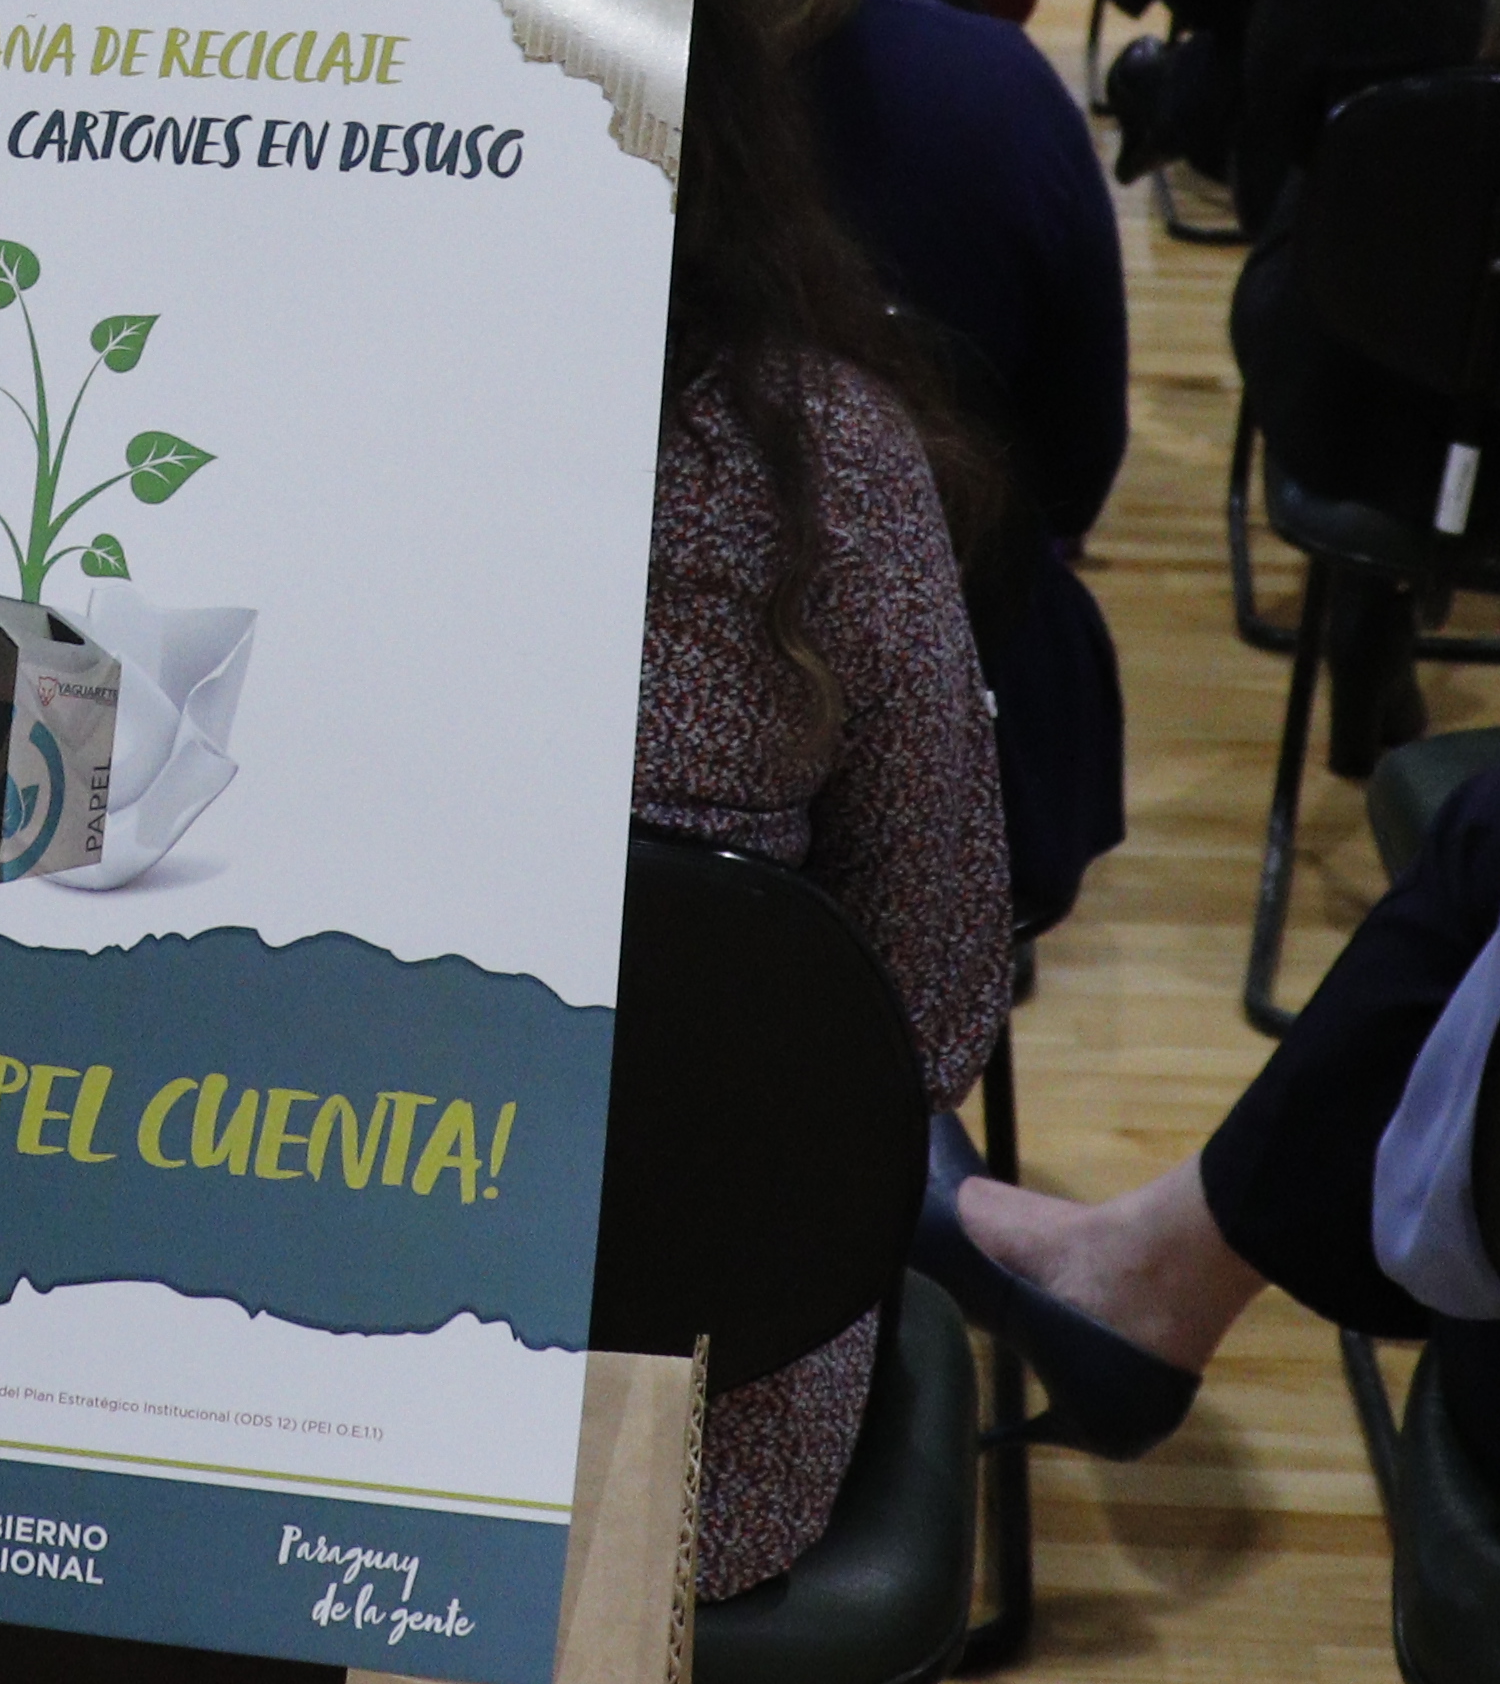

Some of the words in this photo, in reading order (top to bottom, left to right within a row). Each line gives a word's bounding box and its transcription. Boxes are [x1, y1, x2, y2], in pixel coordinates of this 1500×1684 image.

[90, 25, 154, 77] DE
[158, 26, 411, 85] RECICLAJE
[8, 110, 252, 169] CARTONES
[257, 119, 330, 170] EN
[339, 121, 525, 180] DESUSO
[86, 756, 111, 853] PAPEL
[137, 1072, 517, 1205] CUENTA!
[23, 1387, 54, 1404] Plan
[58, 1392, 140, 1414] Estratégico
[143, 1401, 230, 1423] Institucional
[233, 1410, 273, 1428] (ODS
[277, 1414, 298, 1433] 12)
[301, 1418, 332, 1436] (PEI
[277, 1522, 420, 1602] Paraguay
[312, 1582, 352, 1628] de
[354, 1583, 386, 1625] la
[388, 1597, 476, 1646] gente
